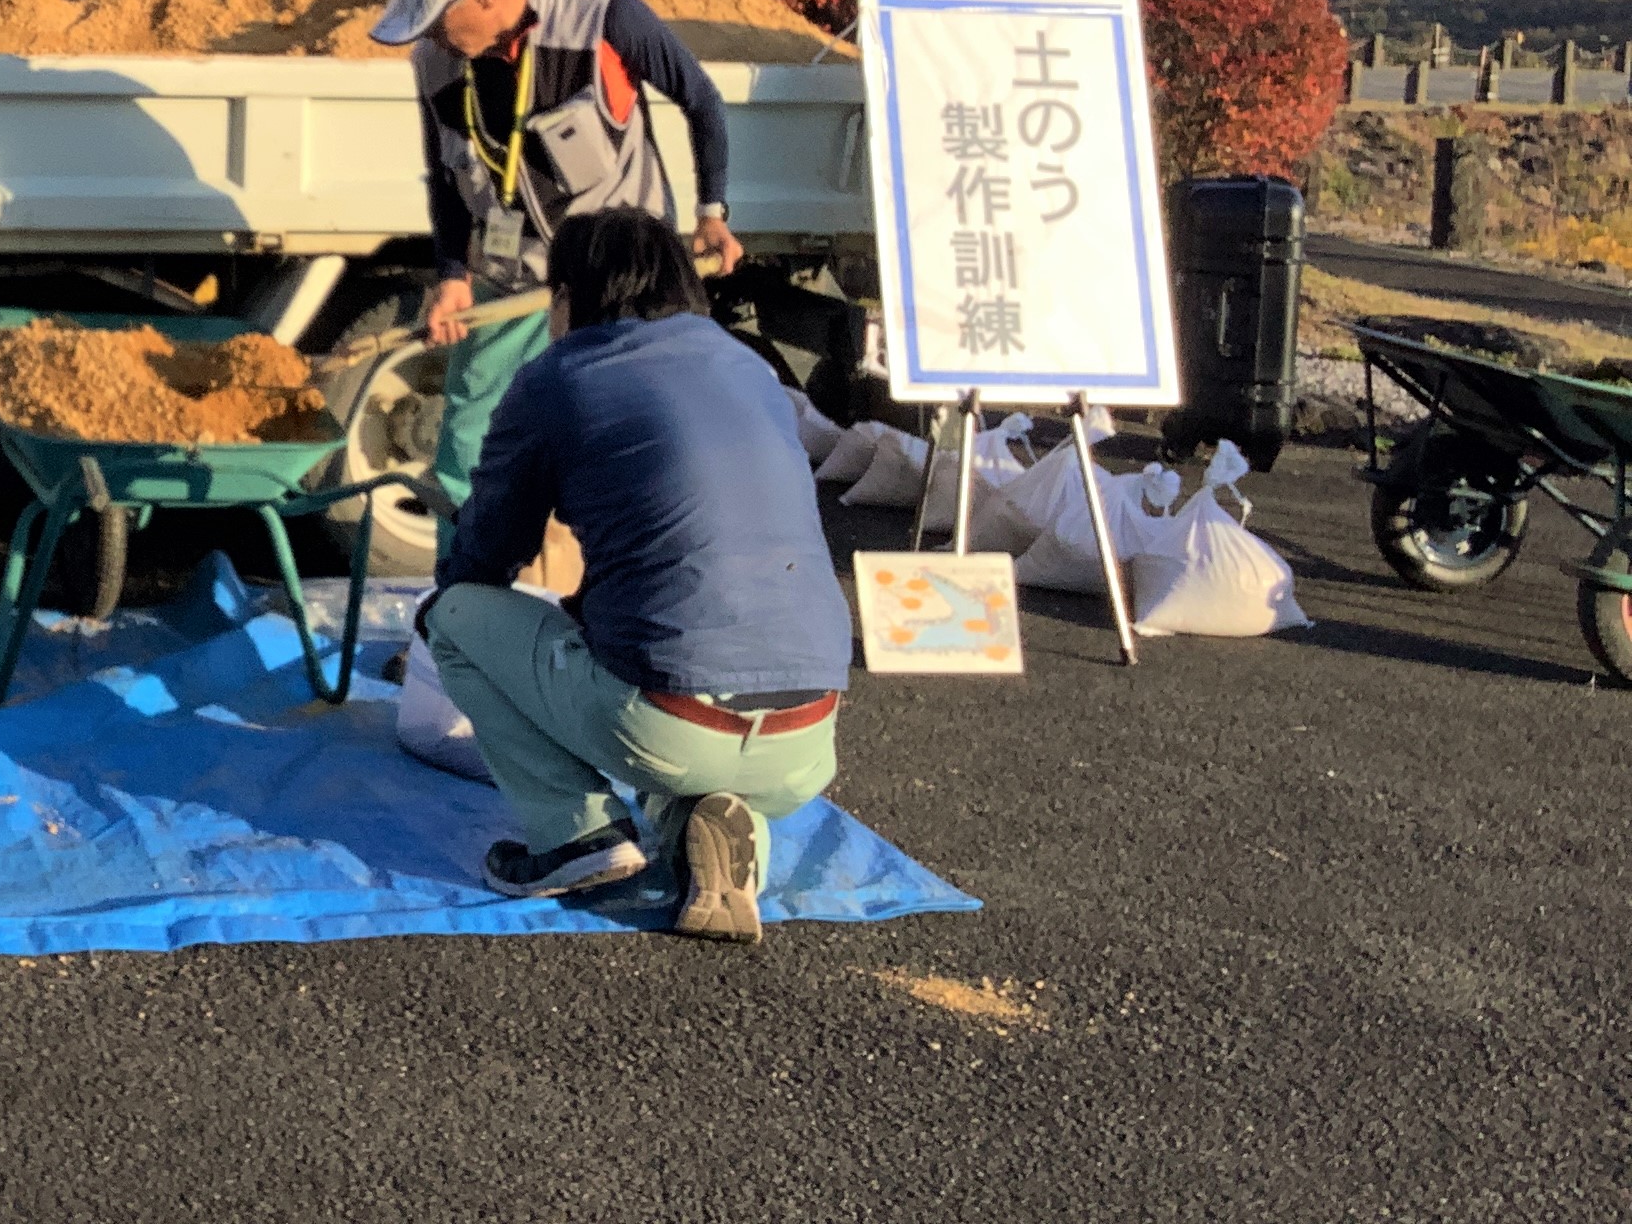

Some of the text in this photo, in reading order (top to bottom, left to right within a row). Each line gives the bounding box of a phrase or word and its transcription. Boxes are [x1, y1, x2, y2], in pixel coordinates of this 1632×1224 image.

[940, 101, 1026, 356] 製作訓練
[1012, 30, 1082, 224] 土のう
